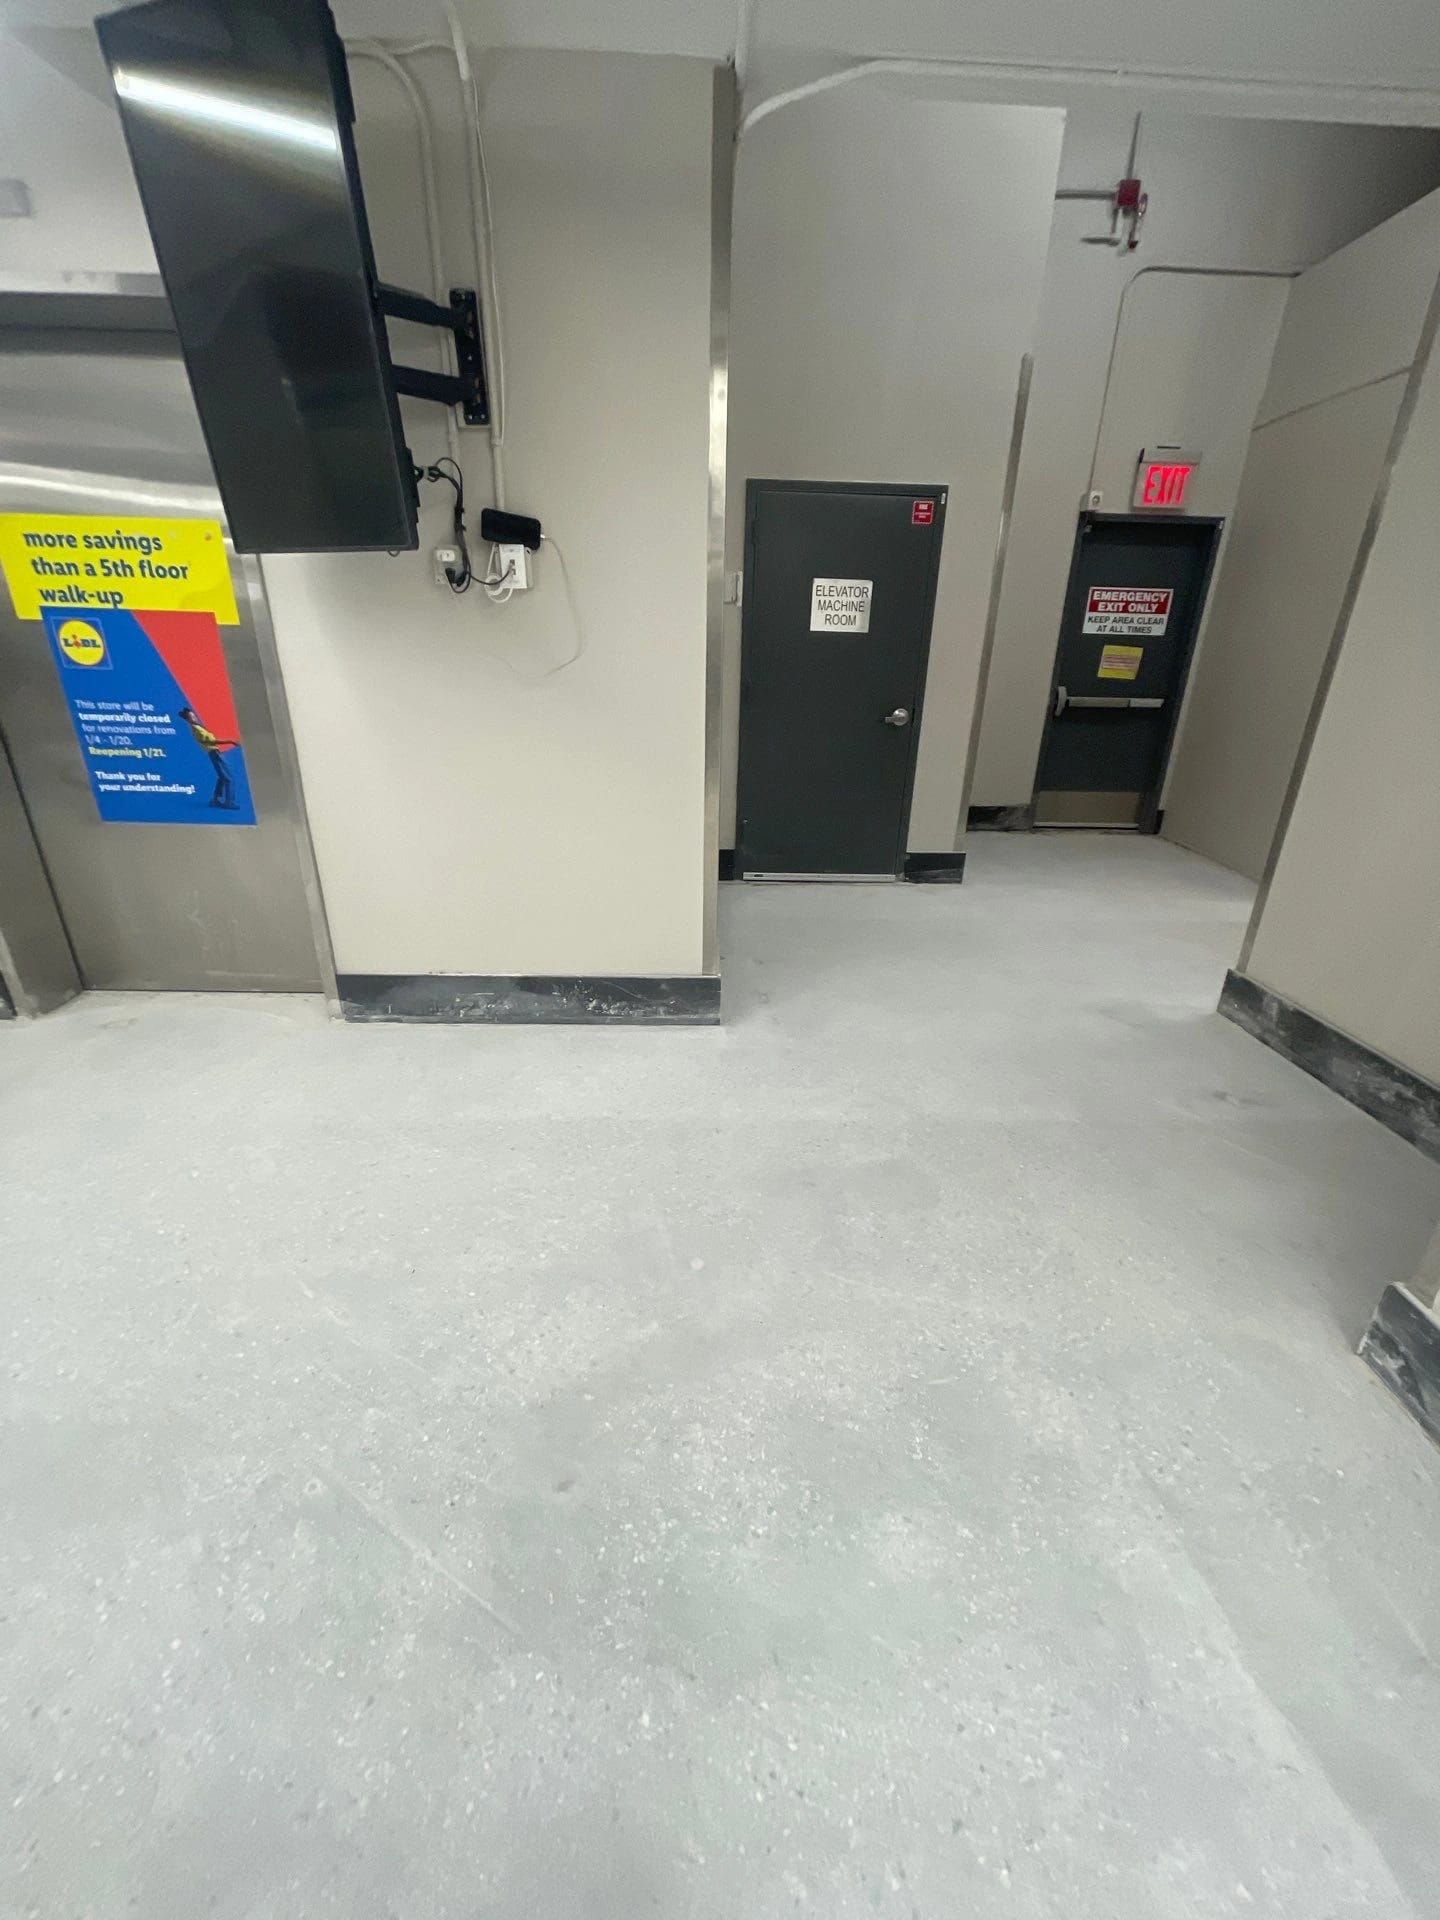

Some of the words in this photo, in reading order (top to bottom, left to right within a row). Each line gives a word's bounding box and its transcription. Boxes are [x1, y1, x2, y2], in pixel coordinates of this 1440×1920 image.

[1143, 464, 1191, 505] EXIT
[23, 532, 77, 548] more
[82, 530, 162, 556] savings
[31, 557, 79, 576] than
[84, 562, 97, 576] a
[100, 558, 134, 577] 5th
[138, 560, 188, 579] floor
[39, 585, 124, 609] walk-up
[815, 584, 869, 598] ELEVATOR
[1092, 590, 1168, 603] EMERGENCY
[817, 599, 865, 612] MACHINE
[1097, 601, 1126, 612] EXIT
[1127, 603, 1160, 613] ONLY
[824, 613, 857, 626] ROOM
[1087, 615, 1111, 624] KEEP
[1111, 616, 1135, 625] AREA
[1136, 617, 1165, 625] CLEAR
[1096, 625, 1107, 633] AT
[1109, 625, 1125, 634] ALL
[1127, 625, 1153, 634] TIMES
[75, 700, 96, 709] This
[97, 702, 121, 710] store
[122, 702, 140, 711] will
[141, 702, 154, 711] be
[78, 713, 136, 723] temporarily
[138, 714, 171, 723] closed
[81, 723, 96, 733] for
[97, 725, 152, 734] renovations
[153, 726, 177, 735] from
[88, 746, 142, 758] Reopening
[94, 771, 126, 780] Thank
[128, 774, 146, 782] you
[146, 773, 161, 781] for
[99, 784, 120, 793] your
[122, 784, 196, 795] understanding!
